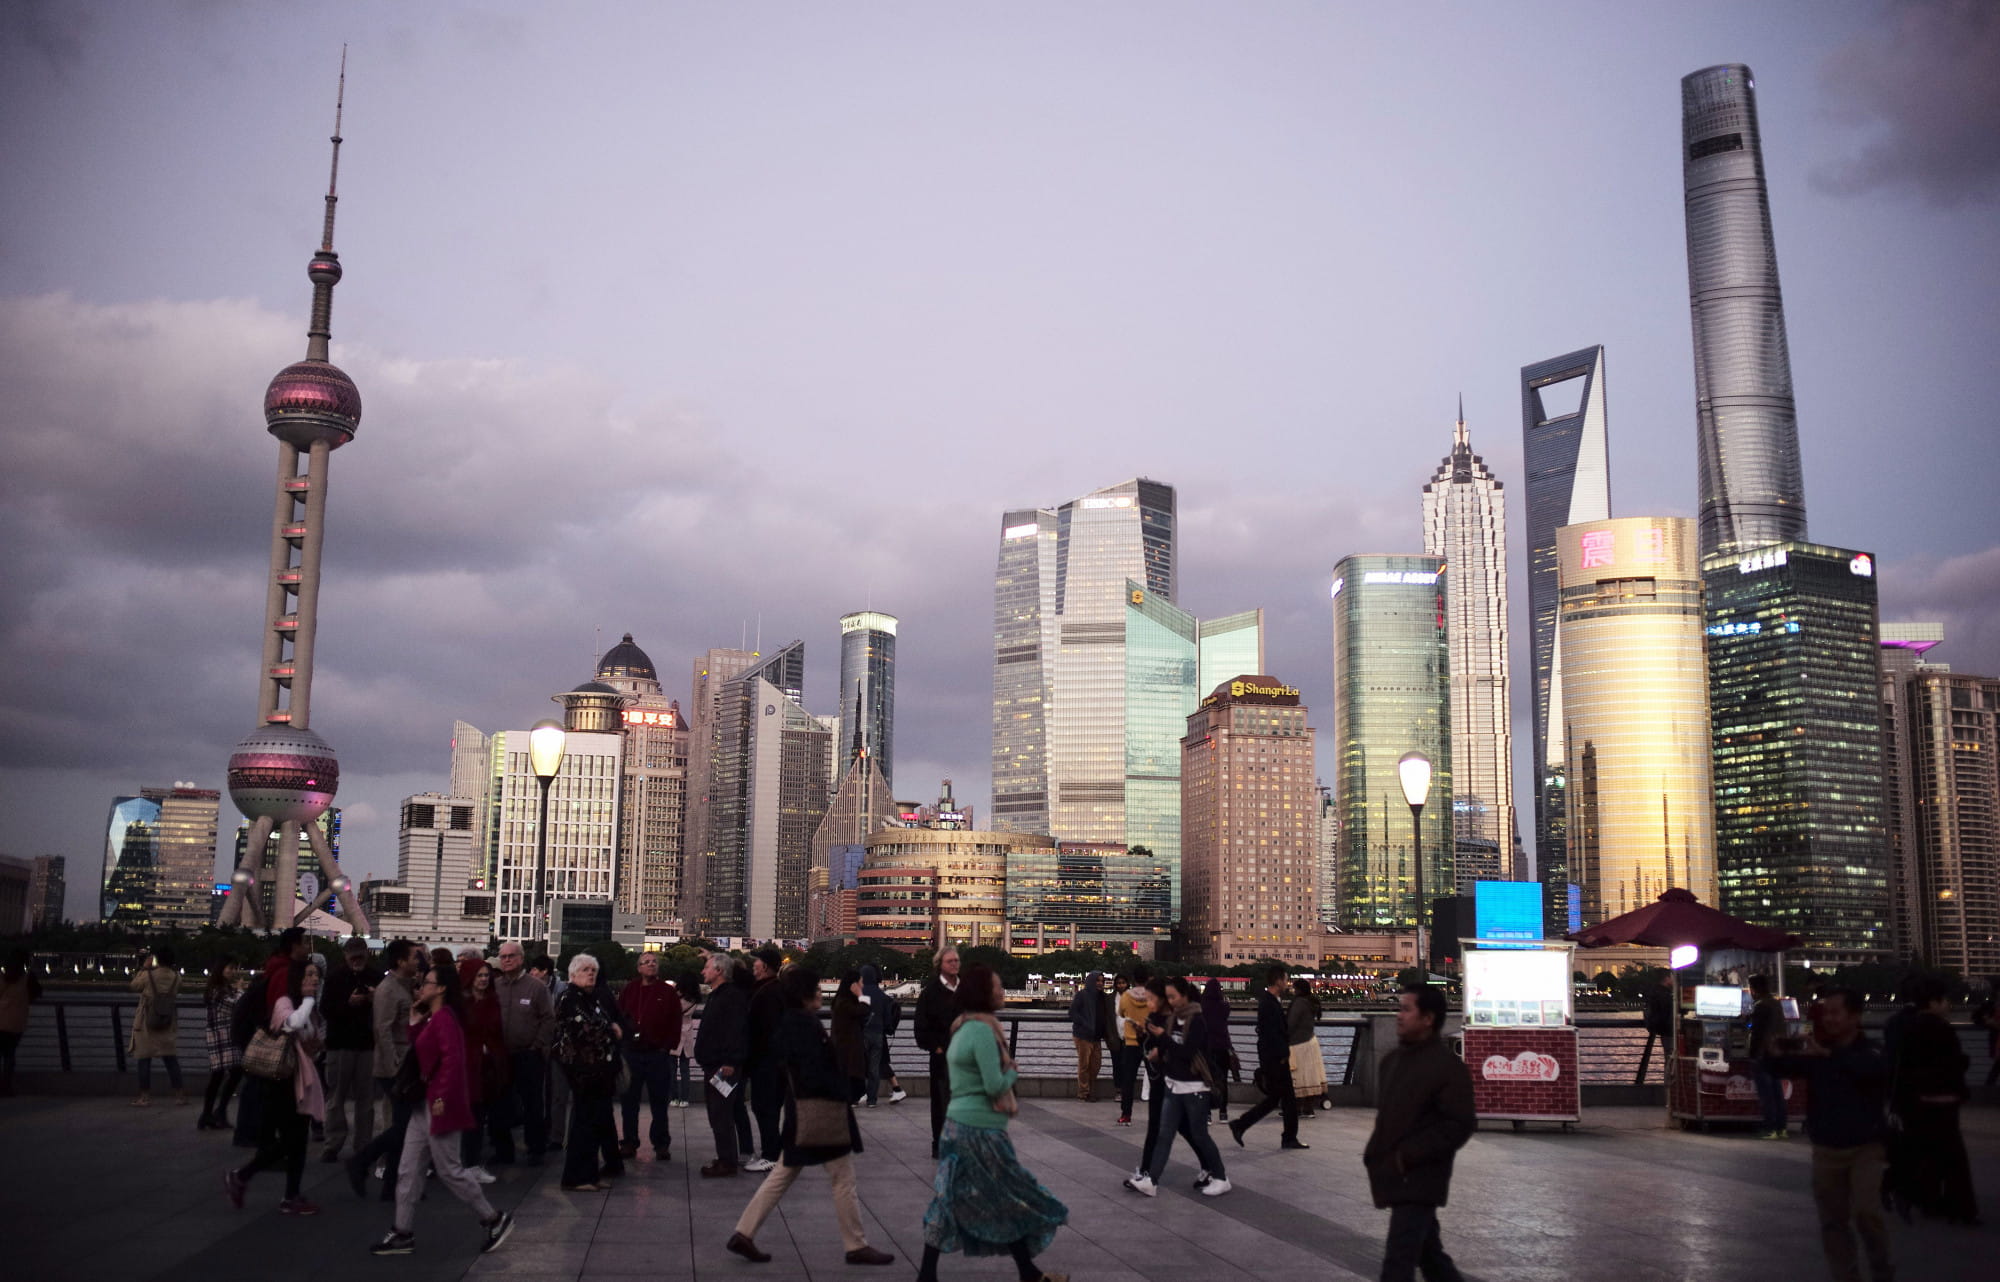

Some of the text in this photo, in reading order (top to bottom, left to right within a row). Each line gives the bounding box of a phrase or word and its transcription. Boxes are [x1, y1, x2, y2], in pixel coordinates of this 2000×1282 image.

[1580, 529, 1668, 570] 震旦
[1245, 682, 1299, 698] Shangri-La
[898, 832, 937, 842] SUPER
